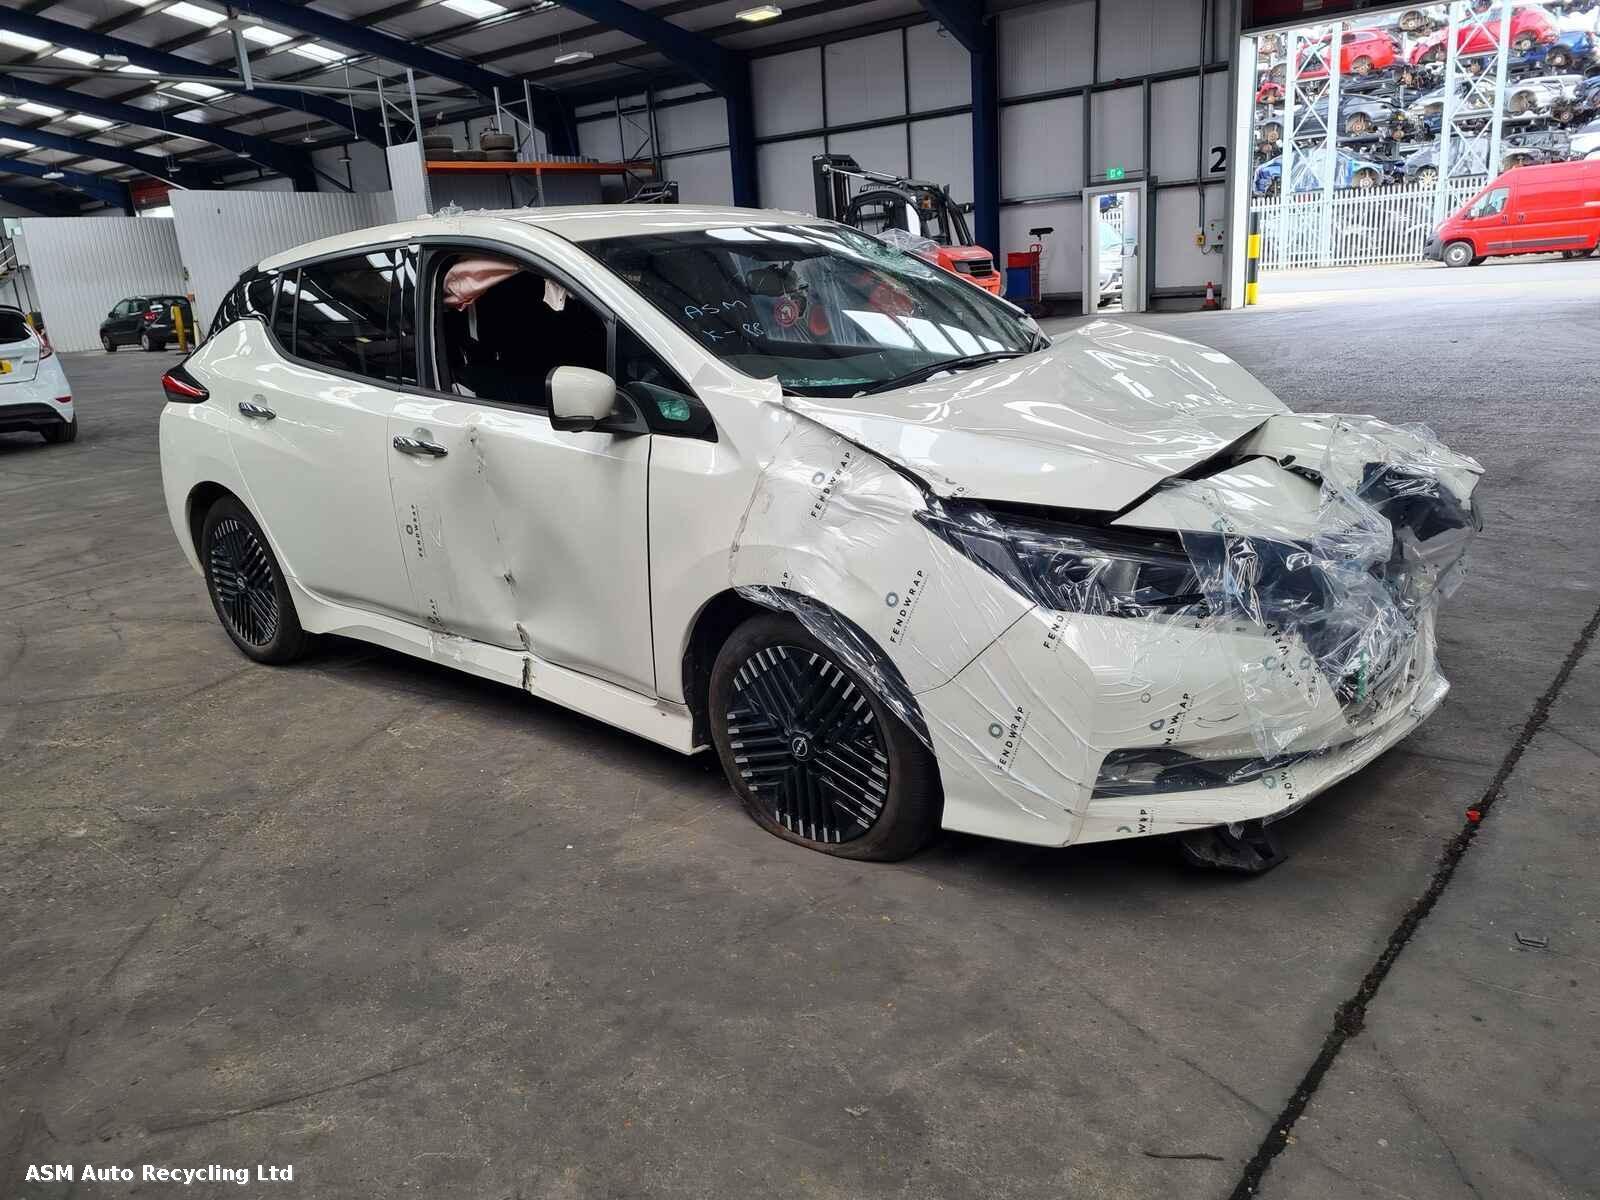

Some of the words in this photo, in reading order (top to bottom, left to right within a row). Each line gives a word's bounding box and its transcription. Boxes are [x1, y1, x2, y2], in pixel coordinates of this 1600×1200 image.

[1210, 146, 1227, 173] 2
[683, 300, 748, 320] ASM
[810, 451, 851, 518] FENDWRAP
[889, 569, 924, 643] FENDWRAP
[1043, 614, 1064, 649] FEND
[996, 706, 1024, 770] FENDWRAP
